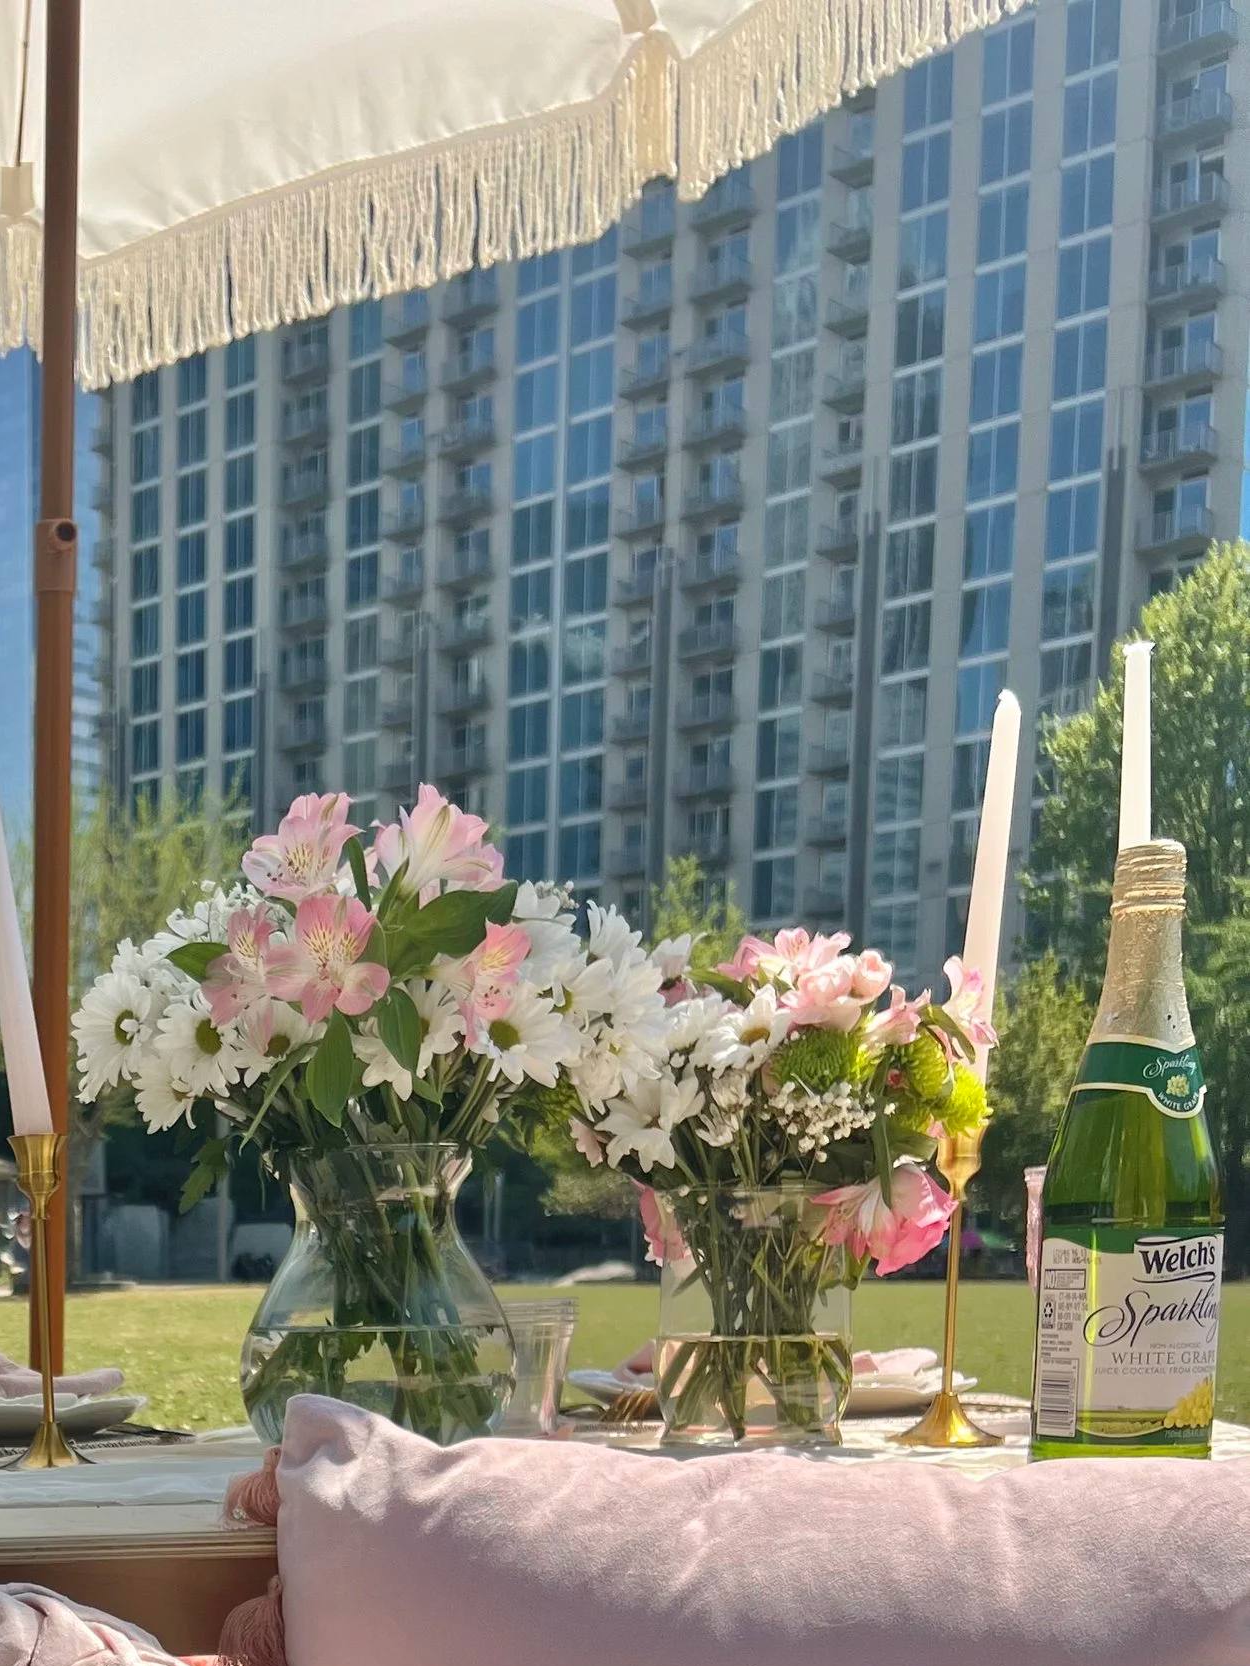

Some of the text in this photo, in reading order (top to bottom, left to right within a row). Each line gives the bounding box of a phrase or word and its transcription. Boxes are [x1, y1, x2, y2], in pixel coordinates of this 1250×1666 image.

[1143, 1055, 1197, 1078] Sparkling
[1158, 1092, 1181, 1110] WHITE
[1139, 1242, 1216, 1274] Welch's
[1112, 1351, 1176, 1365] WHITE
[1122, 1366, 1166, 1376] COCKTAIL
[1169, 1366, 1191, 1375] FROM
